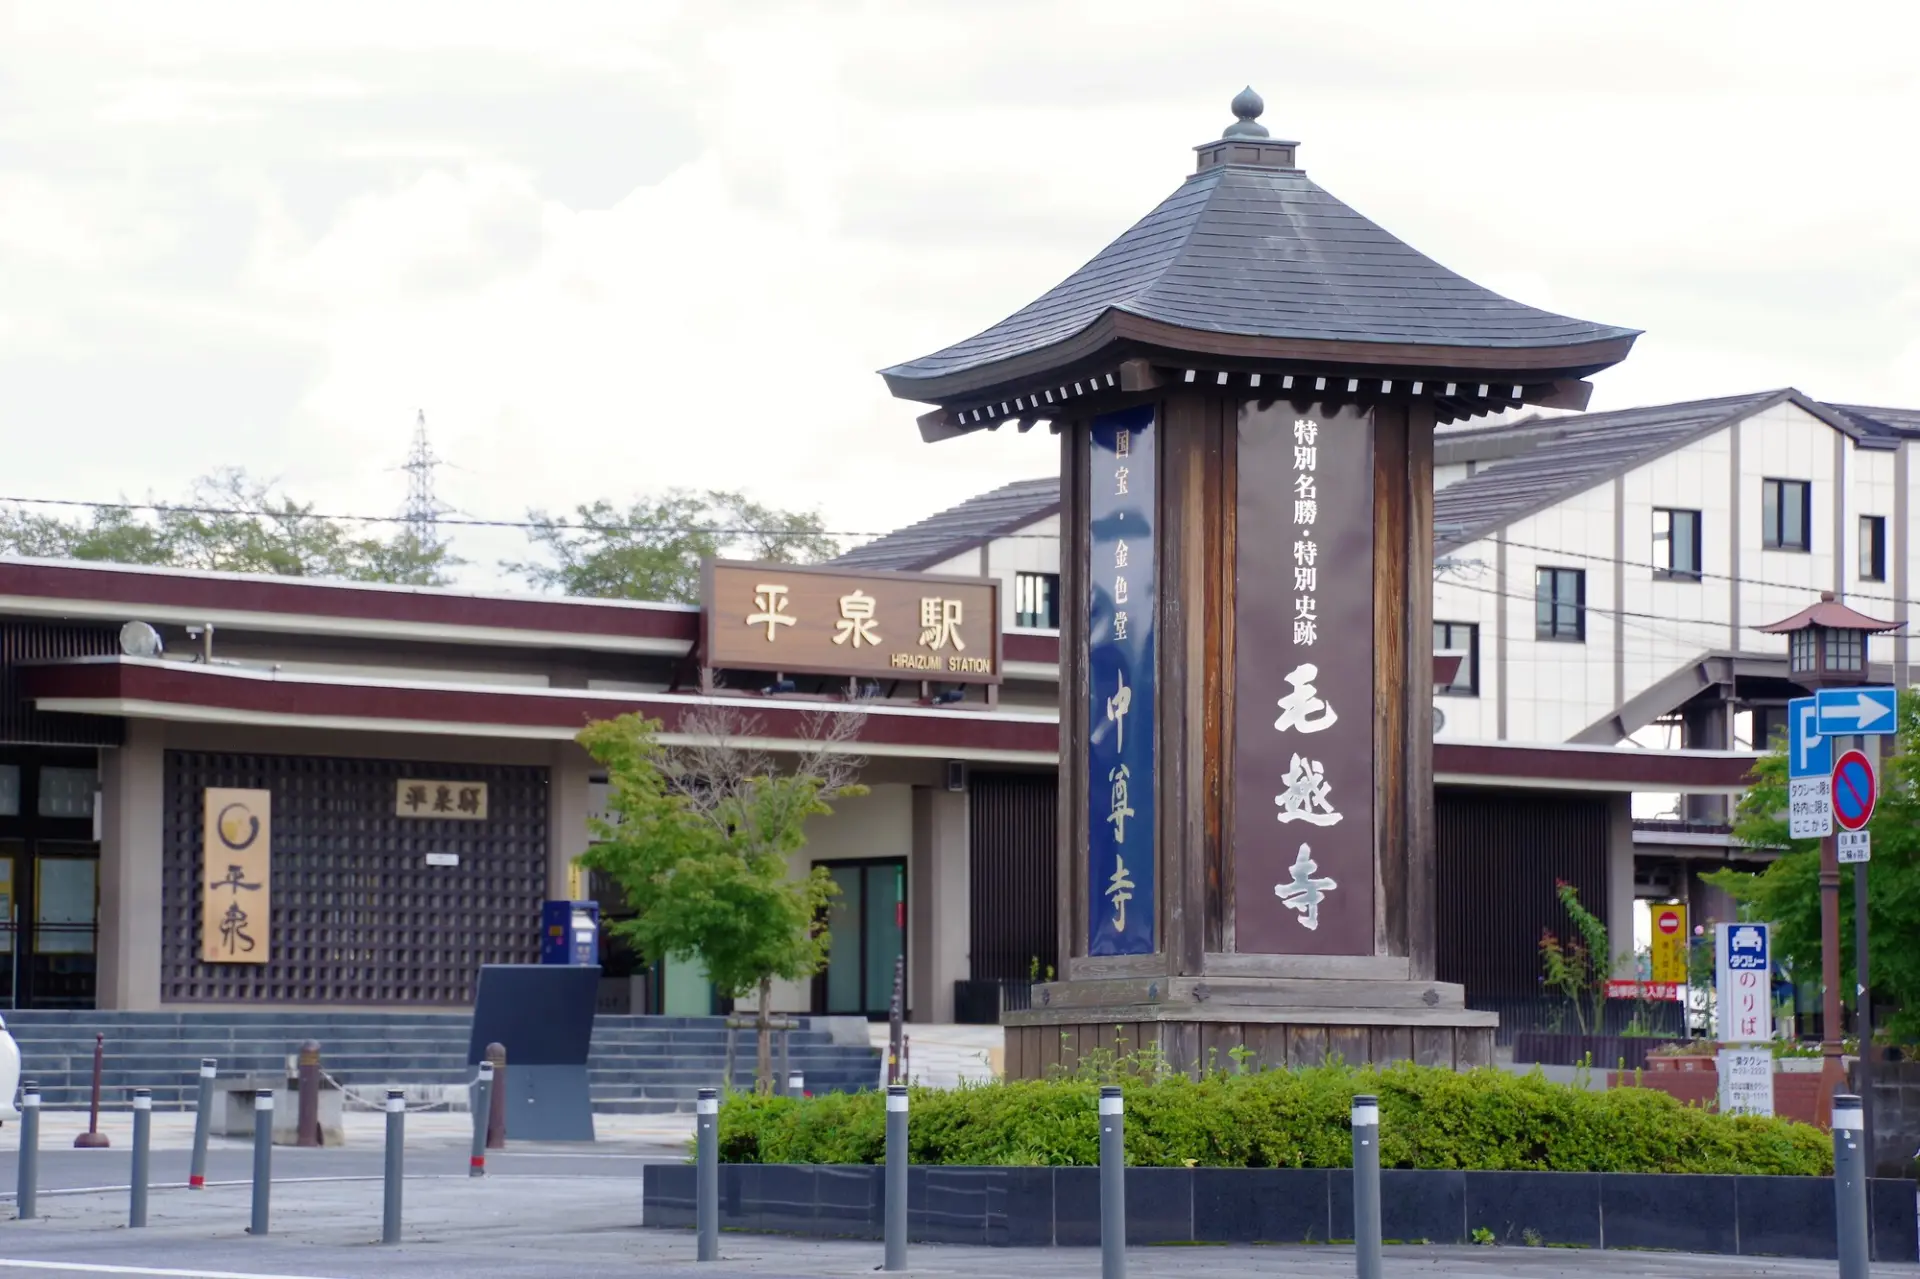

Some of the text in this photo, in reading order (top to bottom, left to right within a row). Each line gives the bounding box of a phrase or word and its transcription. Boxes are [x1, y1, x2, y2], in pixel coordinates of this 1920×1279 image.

[1113, 429, 1129, 640] 国宝・金色堂
[1293, 419, 1318, 646] 特別名勝・特別史跡
[746, 584, 966, 651] 平泉駅
[891, 654, 990, 673] HIRAIZUMI STATION
[1105, 668, 1135, 932] 中尊寺
[1274, 663, 1343, 930] 毛越寺
[1792, 781, 1830, 798] タクシーに限る
[1794, 818, 1829, 833] ここから
[210, 864, 262, 955] 平泉
[1730, 955, 1764, 968] タクシー
[1740, 972, 1756, 1035] のりば
